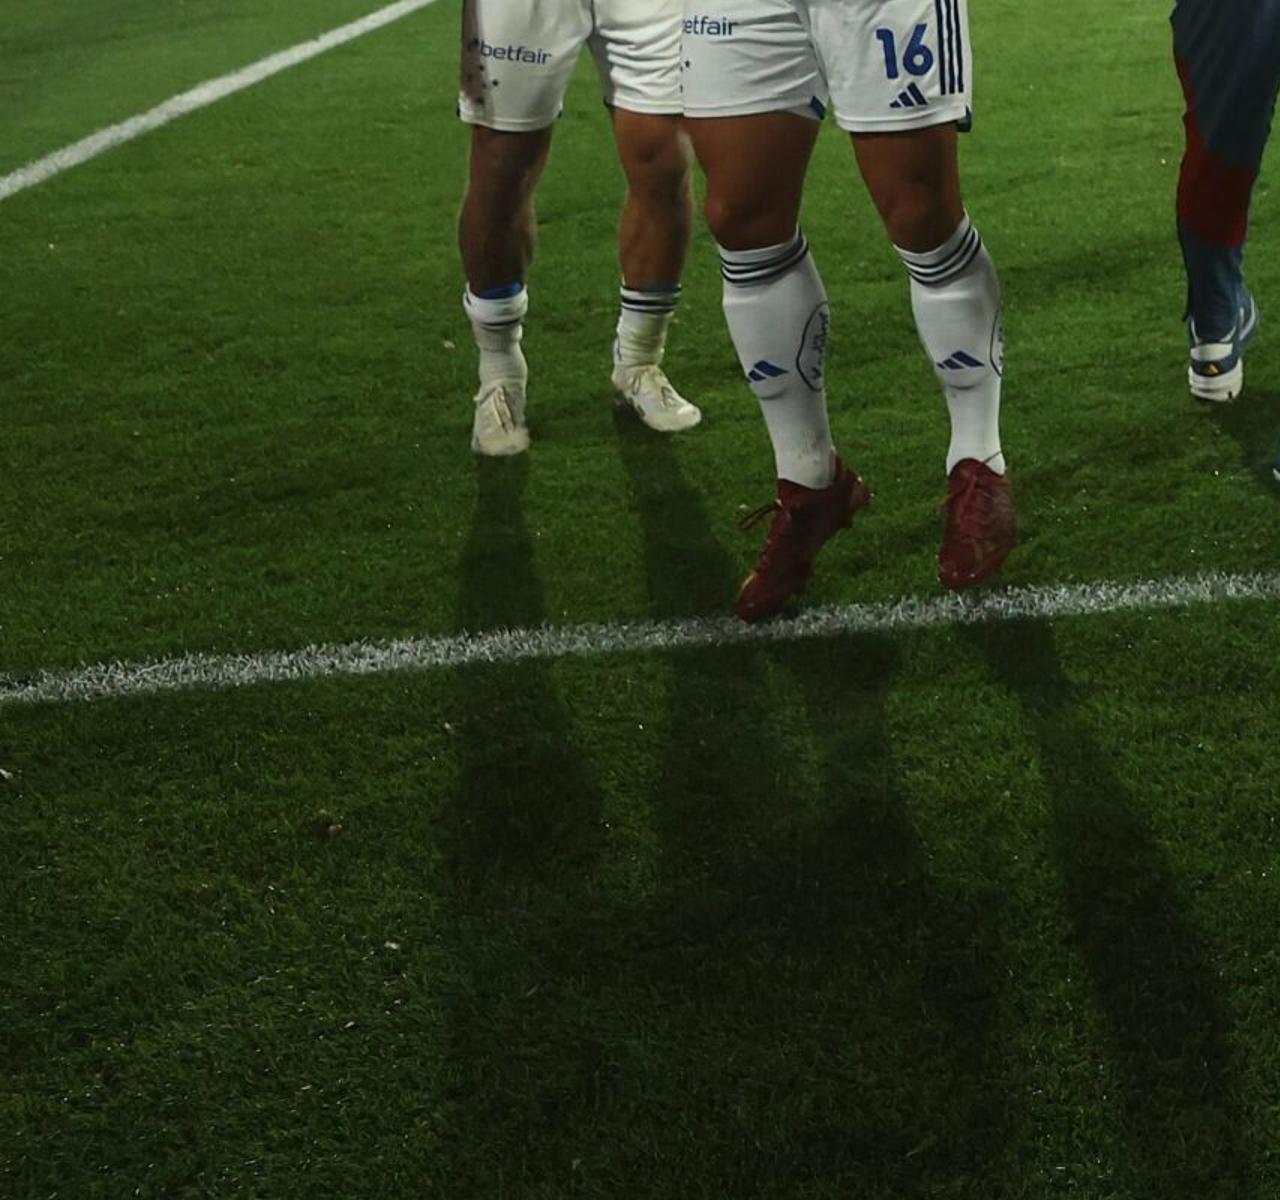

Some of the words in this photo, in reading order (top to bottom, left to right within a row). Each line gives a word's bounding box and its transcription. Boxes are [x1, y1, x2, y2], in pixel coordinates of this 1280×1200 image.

[683, 17, 740, 36] etfair
[479, 39, 553, 65] betfair
[876, 24, 934, 79] 16
